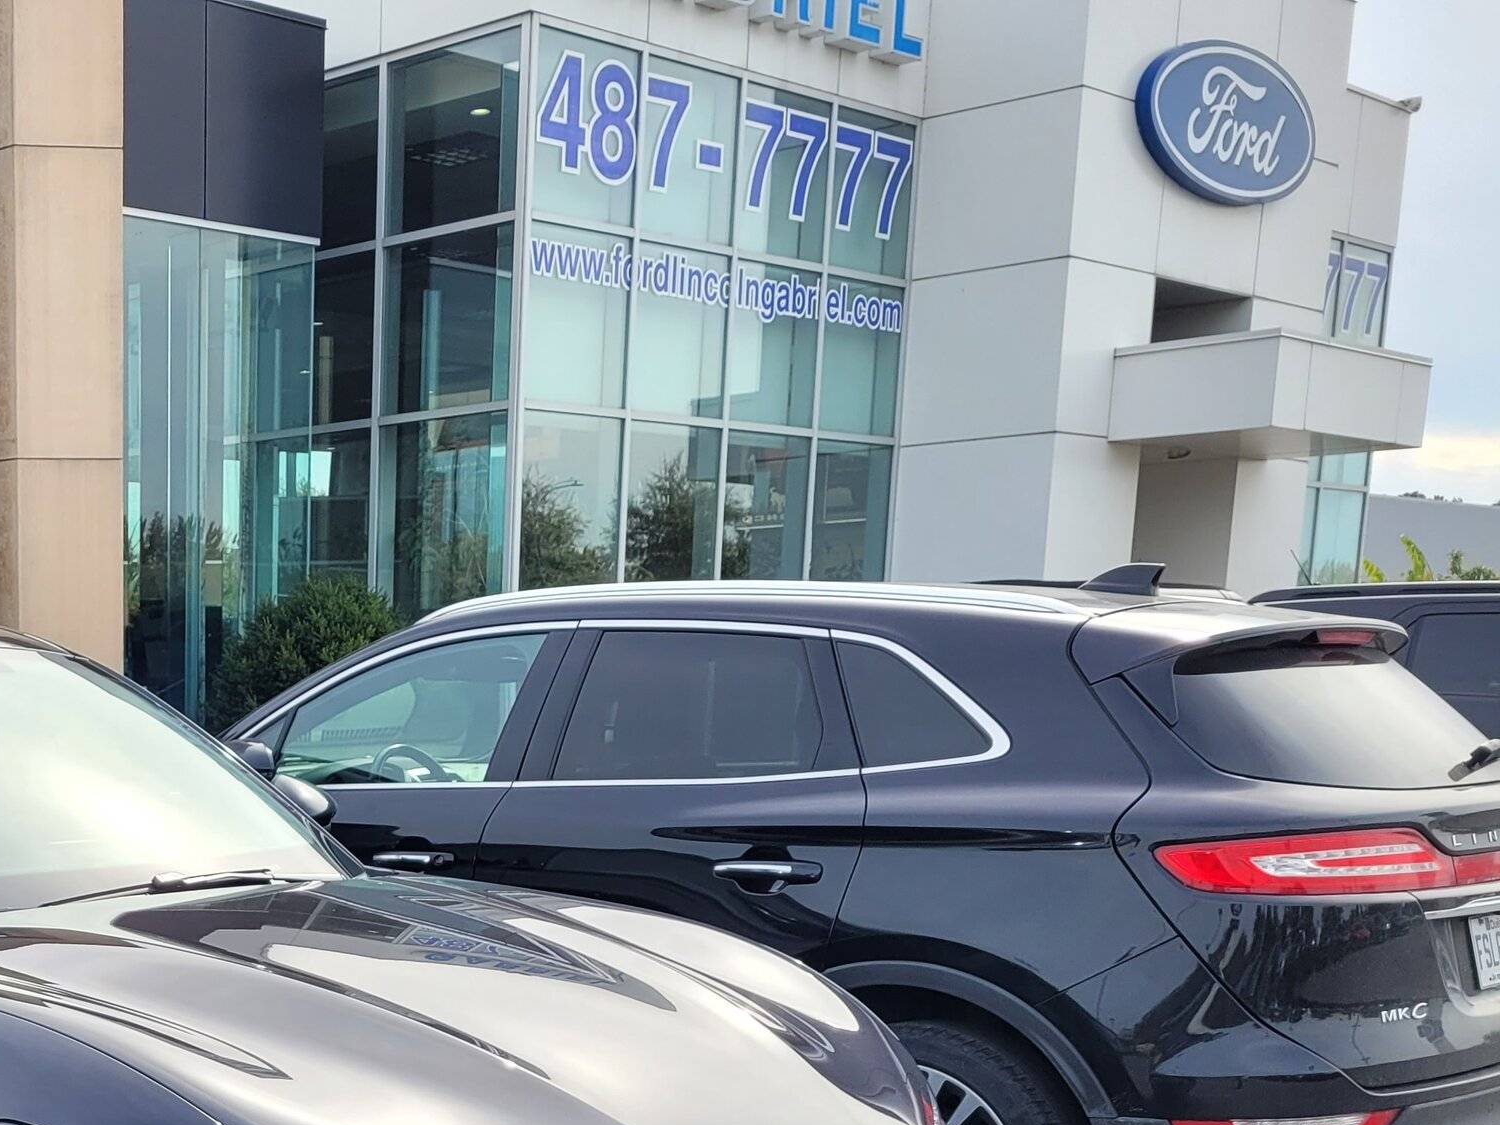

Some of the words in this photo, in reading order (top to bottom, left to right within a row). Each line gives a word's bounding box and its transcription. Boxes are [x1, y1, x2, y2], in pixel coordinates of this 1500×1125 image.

[536, 49, 913, 240] 487-7777
[1186, 65, 1287, 177] Ford
[531, 238, 902, 333] www.fordlincolngabrel.com
[1380, 1001, 1429, 1023] MKC
